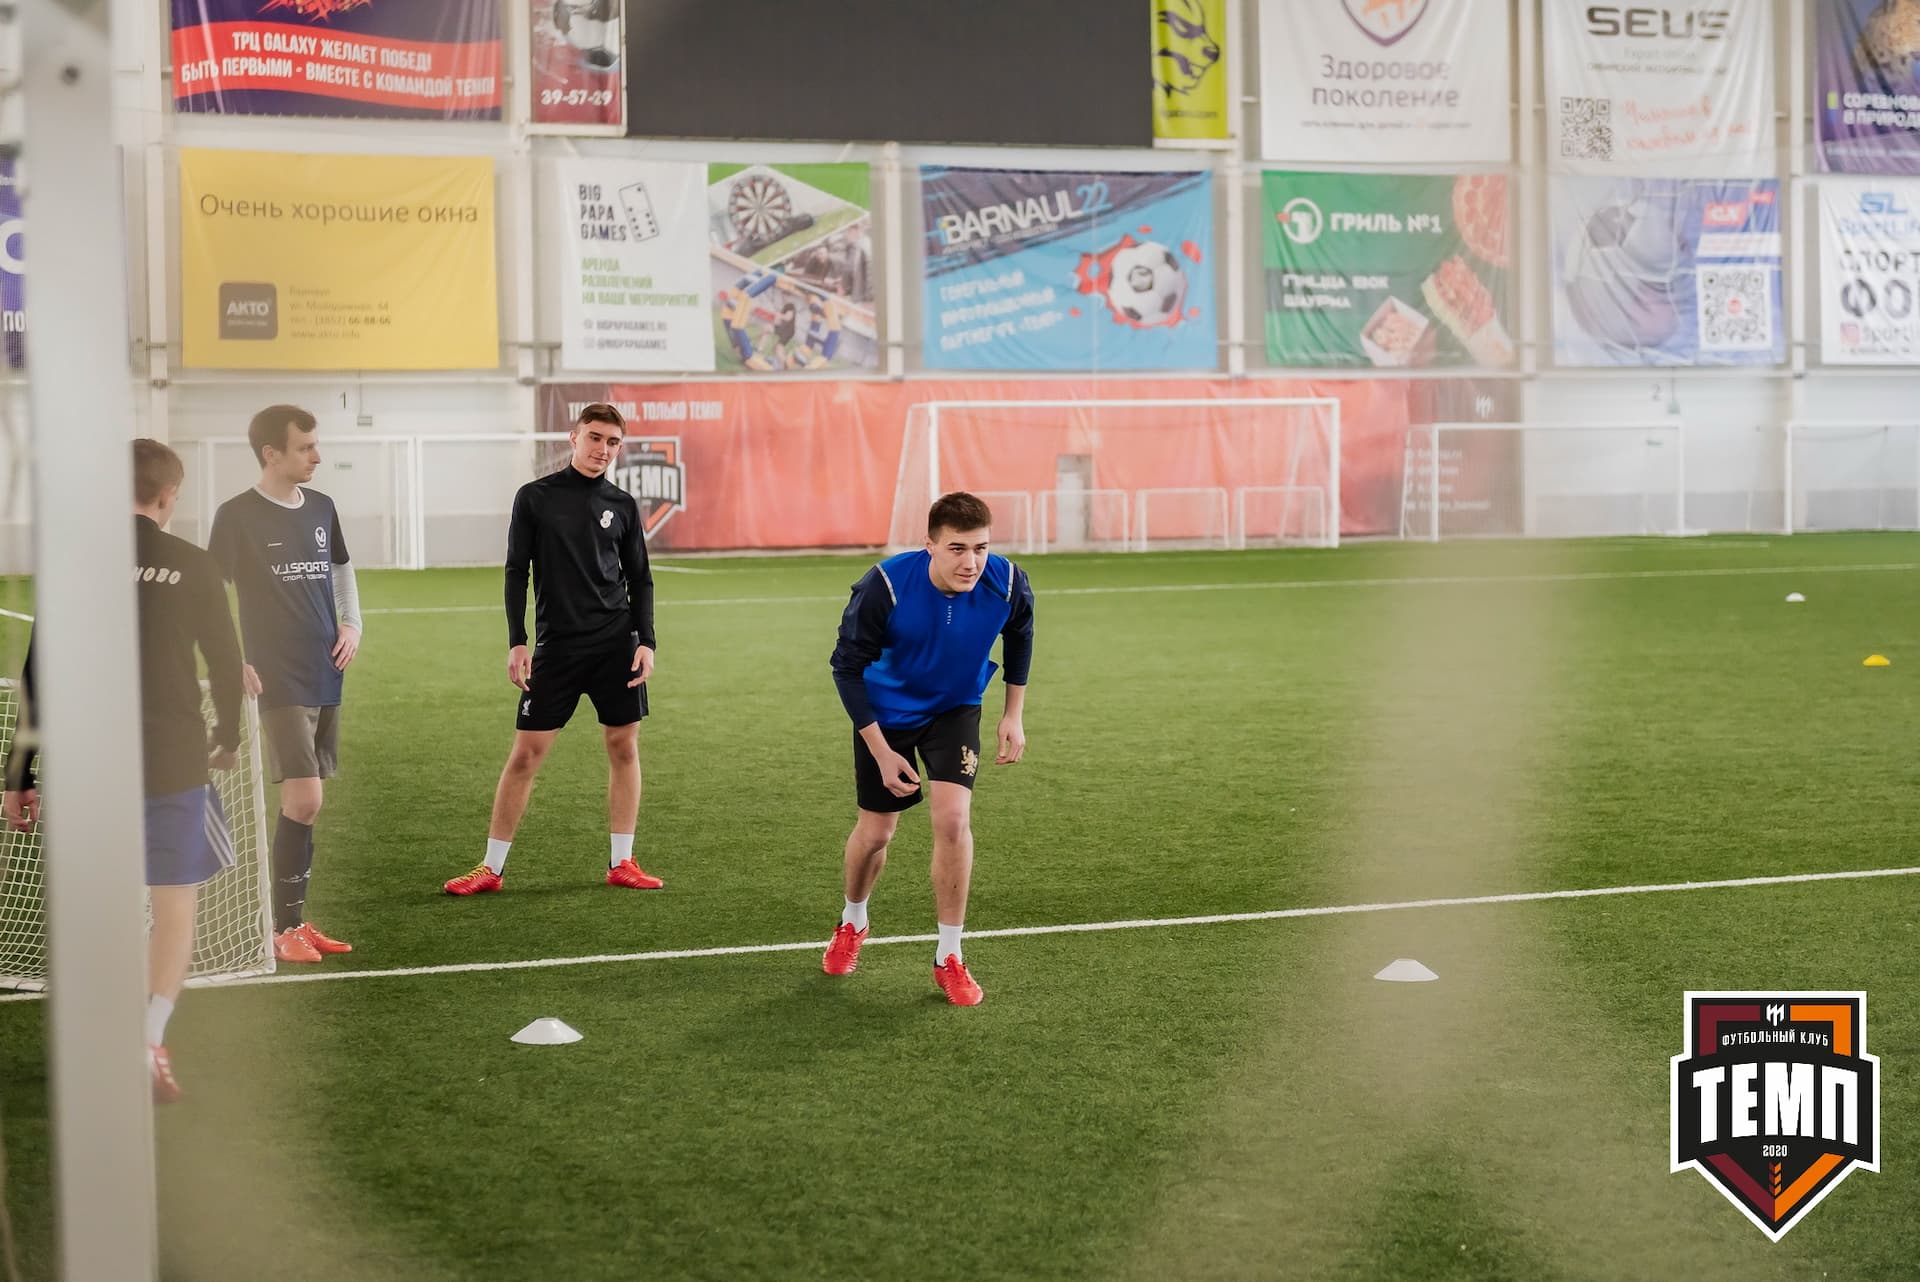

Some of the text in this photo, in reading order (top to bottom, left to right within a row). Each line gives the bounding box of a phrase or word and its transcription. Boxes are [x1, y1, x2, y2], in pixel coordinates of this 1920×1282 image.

[1587, 7, 1729, 38] SEUS
[232, 32, 260, 52] ТРЦ
[263, 33, 316, 55] GALAXY
[320, 39, 376, 63] ЖЕЛАЕТ
[181, 61, 218, 82] БЫТЬ
[222, 58, 292, 78] ПЕРВЫМИ
[305, 63, 359, 87] ВМЕСТЕ
[363, 70, 372, 89] С
[375, 72, 451, 98] КОМАНДОЙ
[1320, 54, 1449, 80] Здоровое
[541, 89, 613, 105] 39-57-29
[1312, 87, 1460, 107] поколение
[579, 184, 602, 201] BIG
[1860, 192, 1908, 214] SL
[200, 194, 478, 226] Очень хорошие окна
[580, 205, 615, 221] PAPA
[581, 224, 627, 241] GAMES
[1331, 213, 1442, 233] ГРИЛЬ №1
[226, 300, 270, 317] АКТО
[1841, 278, 1920, 319] ФО
[616, 465, 678, 501] ТЕМП
